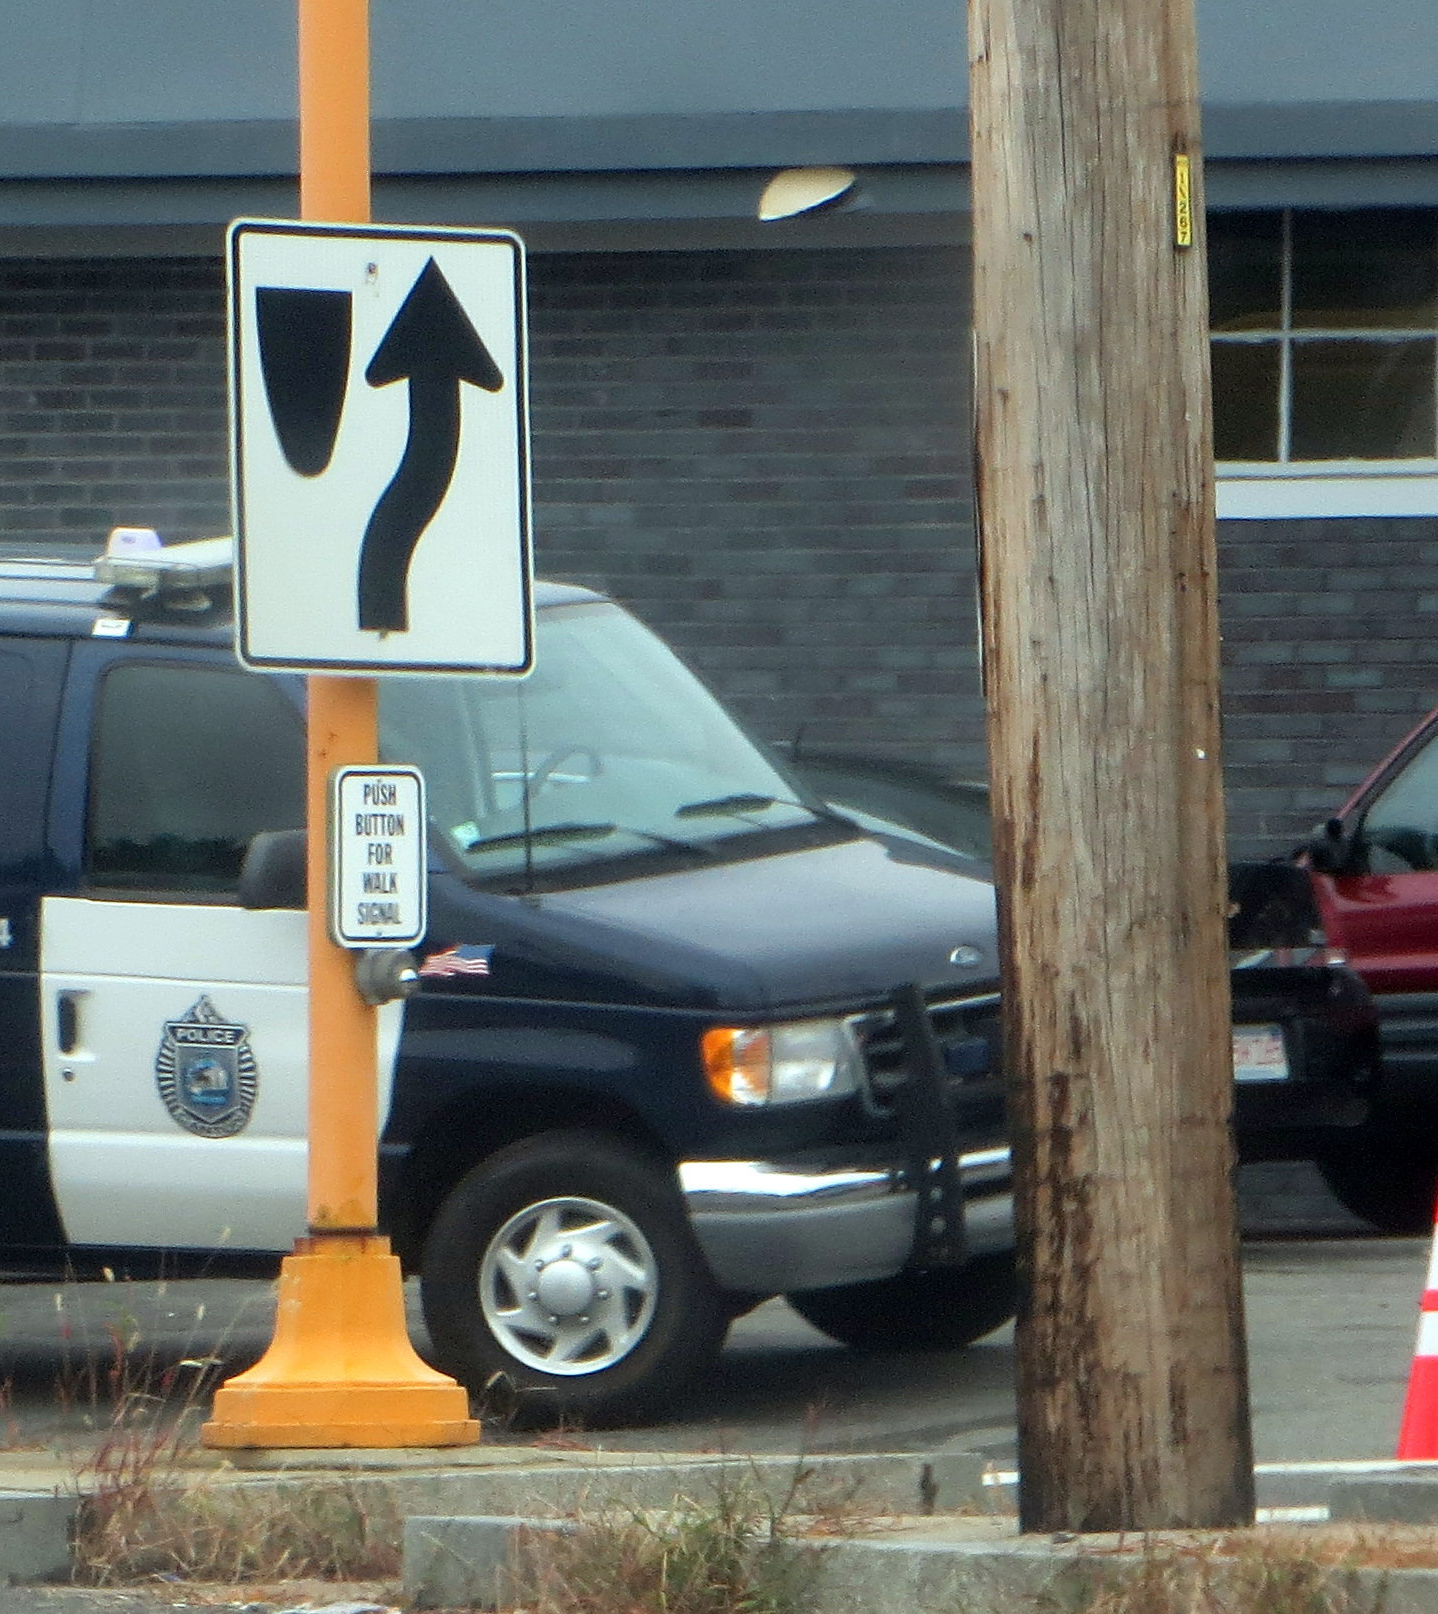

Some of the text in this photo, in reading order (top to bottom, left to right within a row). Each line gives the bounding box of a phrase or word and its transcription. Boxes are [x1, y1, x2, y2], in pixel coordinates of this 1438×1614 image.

[363, 783, 397, 806] PUSH
[355, 813, 404, 837] BUTTON
[368, 843, 393, 865] FOR
[363, 872, 398, 894] WALK
[357, 902, 401, 925] SIGNAL
[175, 1027, 235, 1044] POLICE
